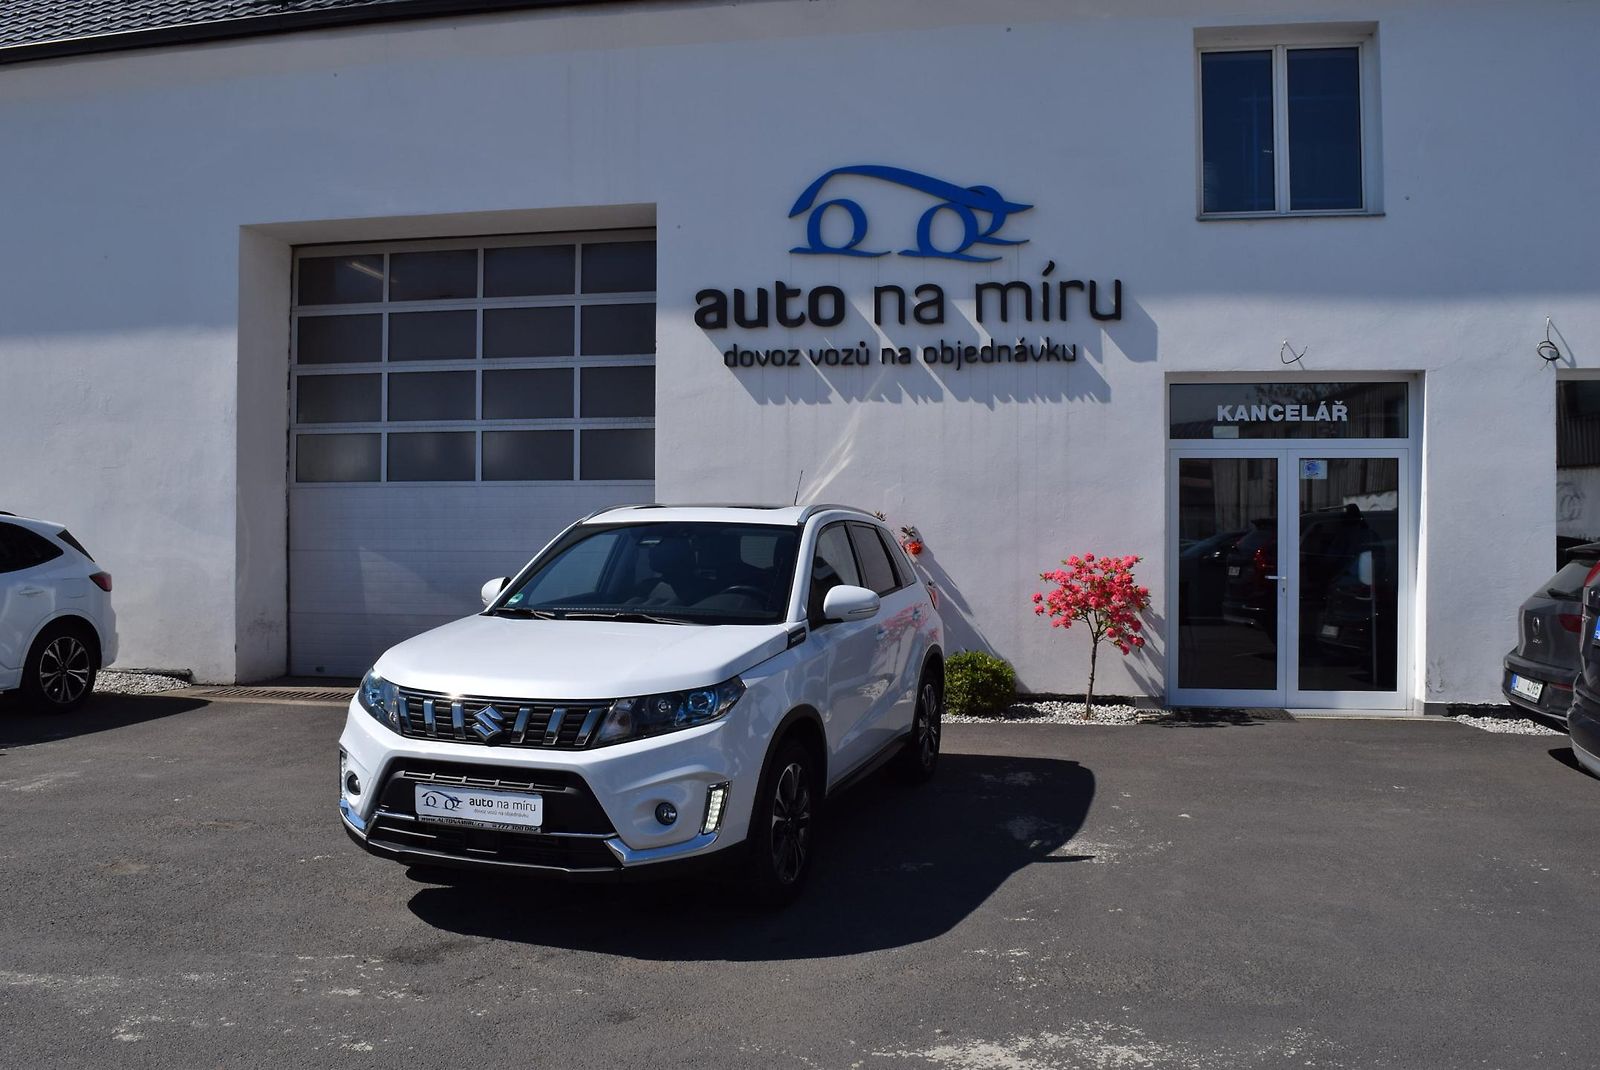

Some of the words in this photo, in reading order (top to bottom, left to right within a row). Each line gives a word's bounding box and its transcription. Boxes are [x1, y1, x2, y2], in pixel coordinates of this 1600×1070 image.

[694, 281, 846, 330] auto
[873, 283, 945, 326] na
[975, 260, 1123, 324] míru
[723, 343, 801, 369] dovoz
[808, 340, 871, 367] vozů
[881, 346, 912, 366] na
[923, 336, 1077, 372] objednávku
[1216, 400, 1349, 422] KANCELÁŘ
[469, 797, 494, 808] auto
[496, 800, 509, 809] na
[512, 799, 536, 812] míru
